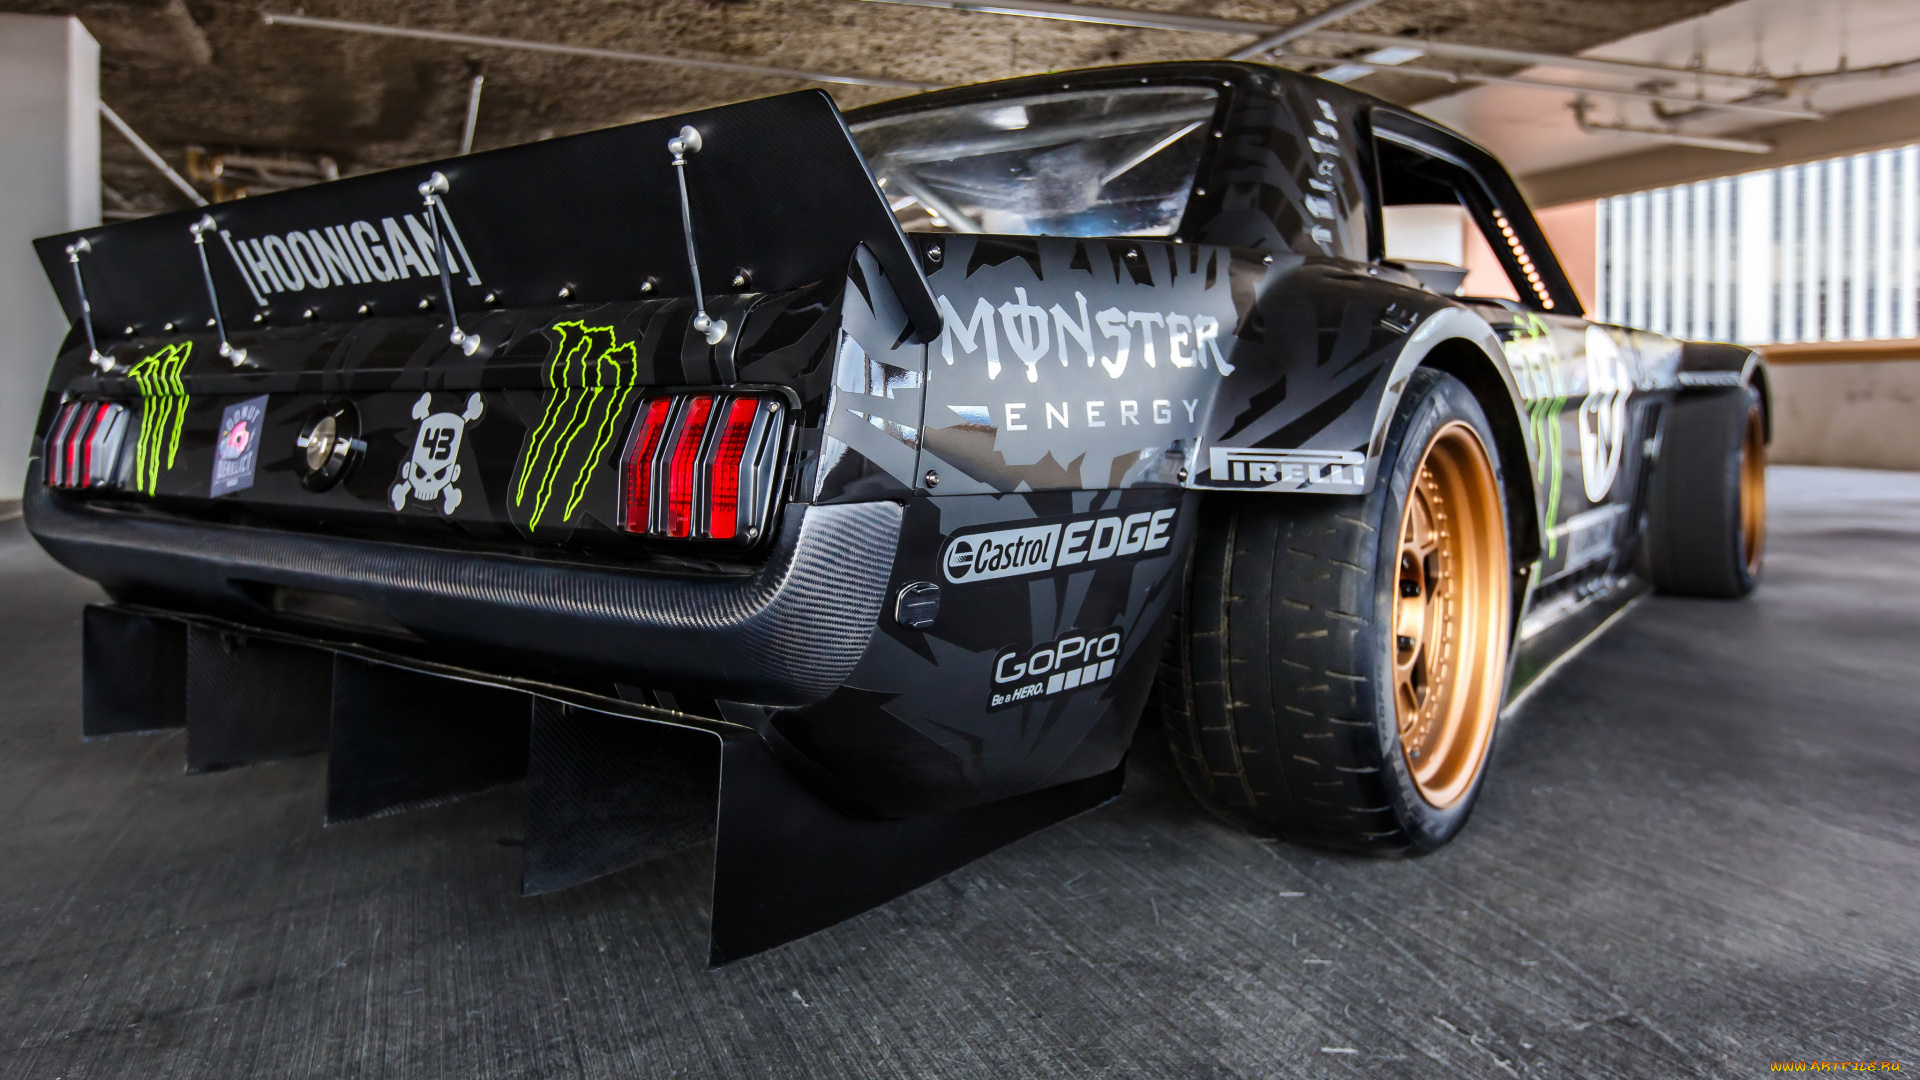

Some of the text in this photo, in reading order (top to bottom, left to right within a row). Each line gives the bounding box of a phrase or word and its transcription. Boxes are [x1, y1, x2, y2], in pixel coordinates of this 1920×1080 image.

[1005, 399, 1199, 431] ENERGY
[422, 427, 456, 460] 43
[1209, 446, 1366, 486] PIRELLI
[974, 507, 1177, 574] Castrol EDGE
[995, 632, 1120, 684] GoPro
[991, 682, 1044, 707] Be a HERO.
